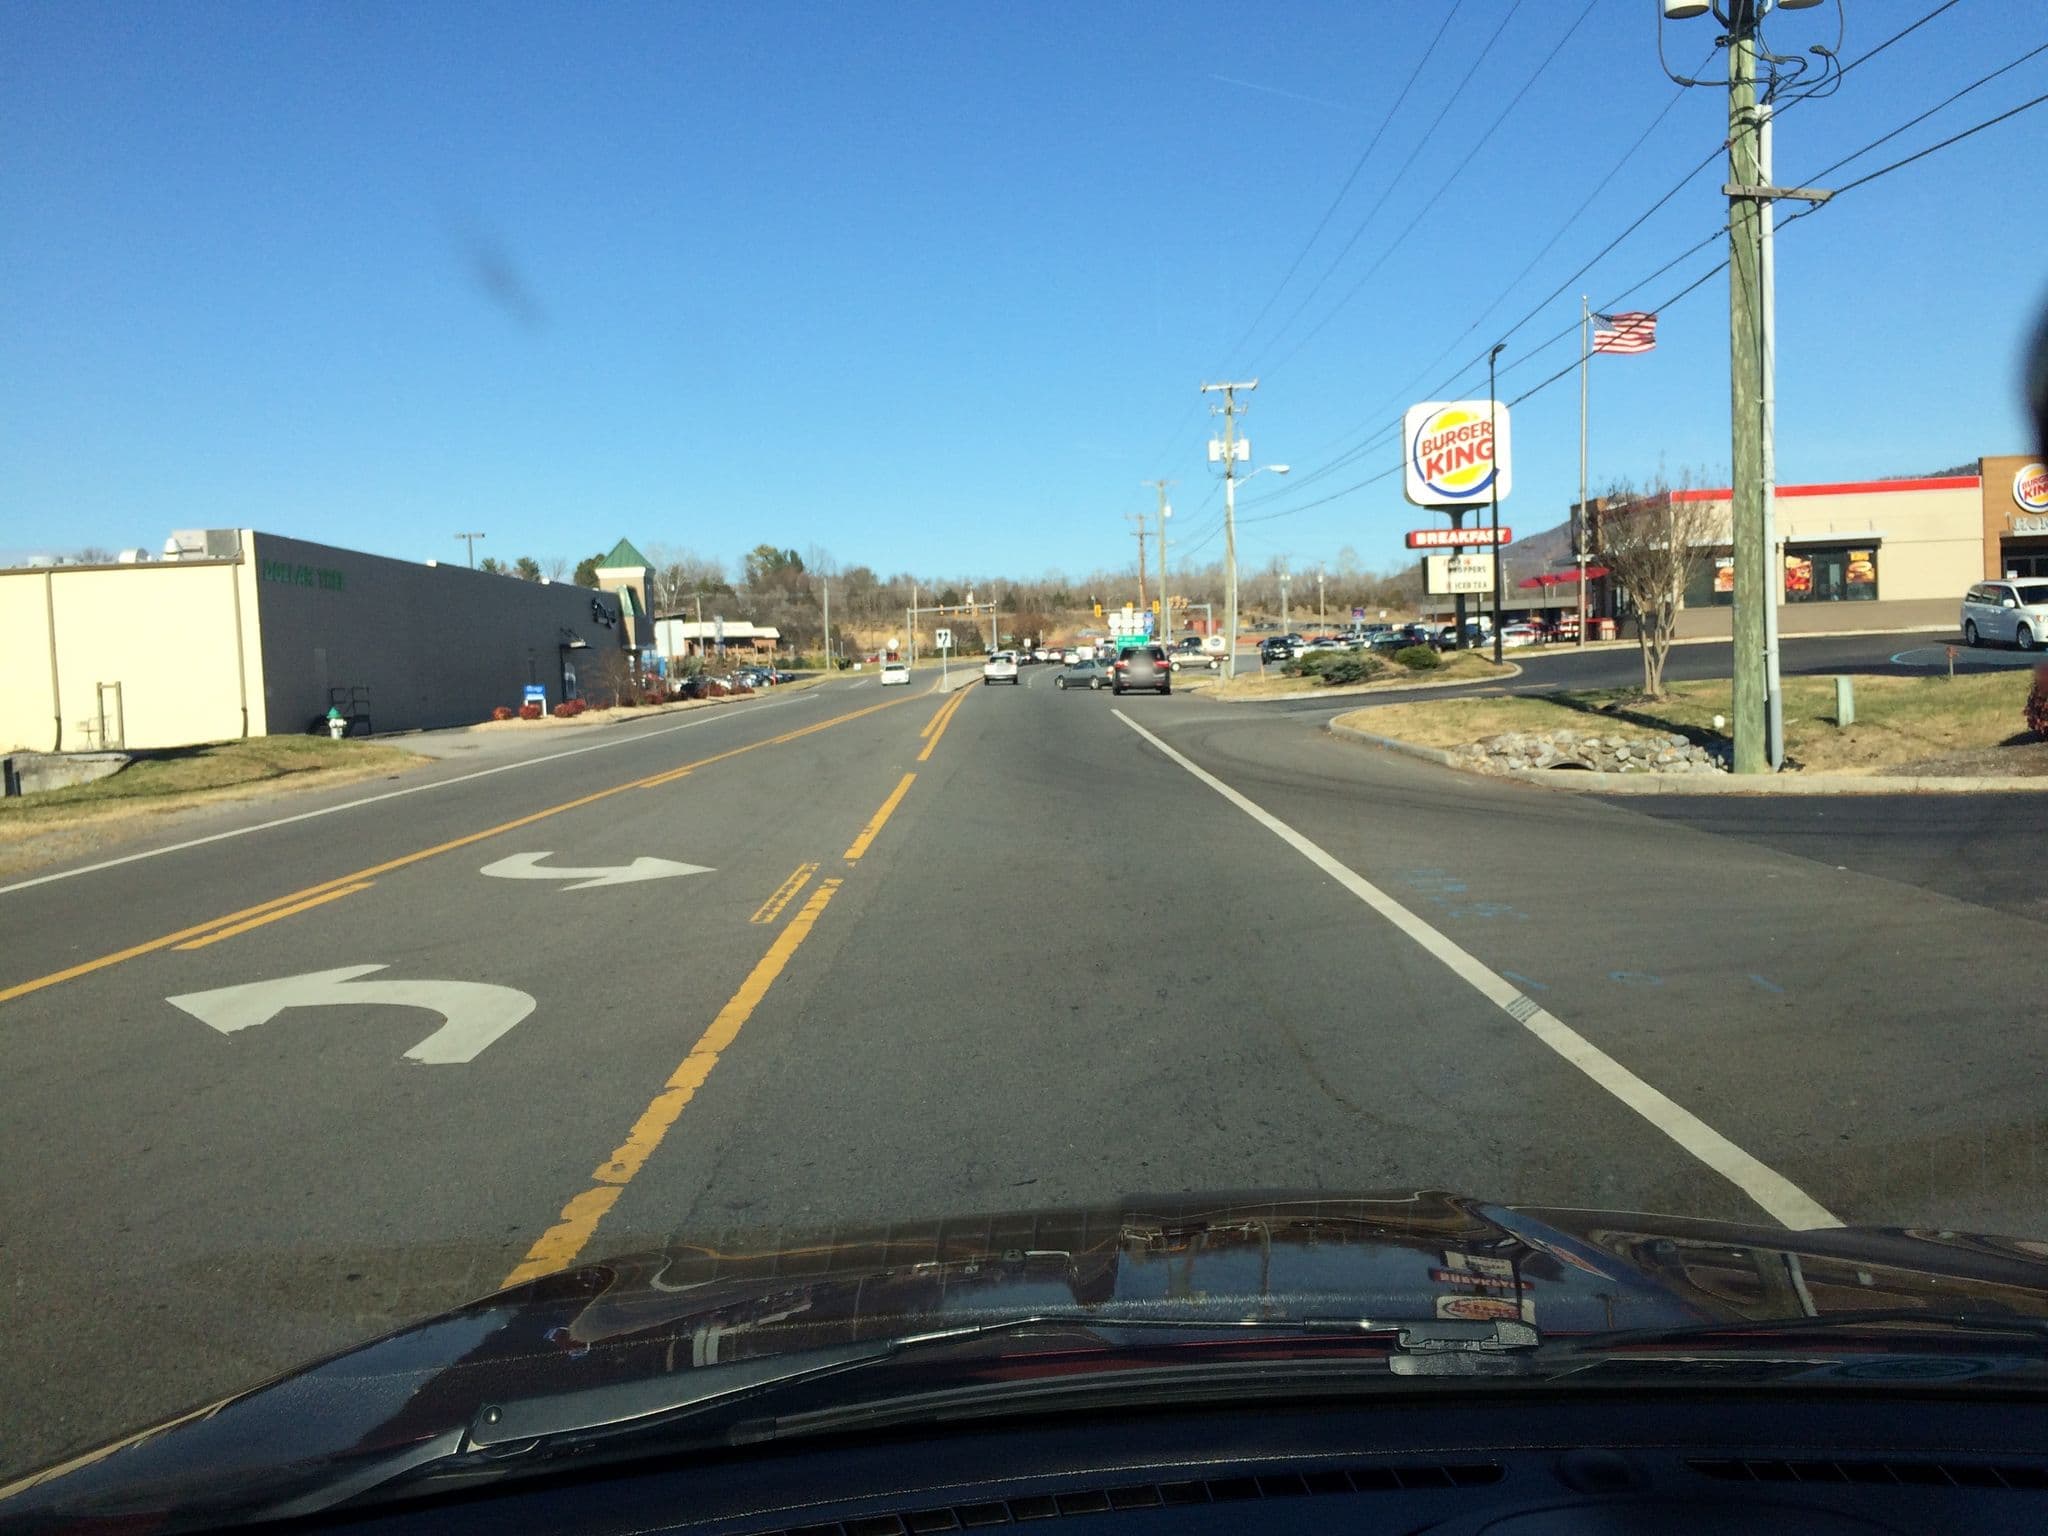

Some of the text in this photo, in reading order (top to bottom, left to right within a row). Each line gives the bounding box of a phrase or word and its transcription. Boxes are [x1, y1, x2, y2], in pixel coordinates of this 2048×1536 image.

[1422, 421, 1493, 457] BURGER
[1427, 438, 1494, 480] KING
[1416, 529, 1506, 545] BREAKFAST
